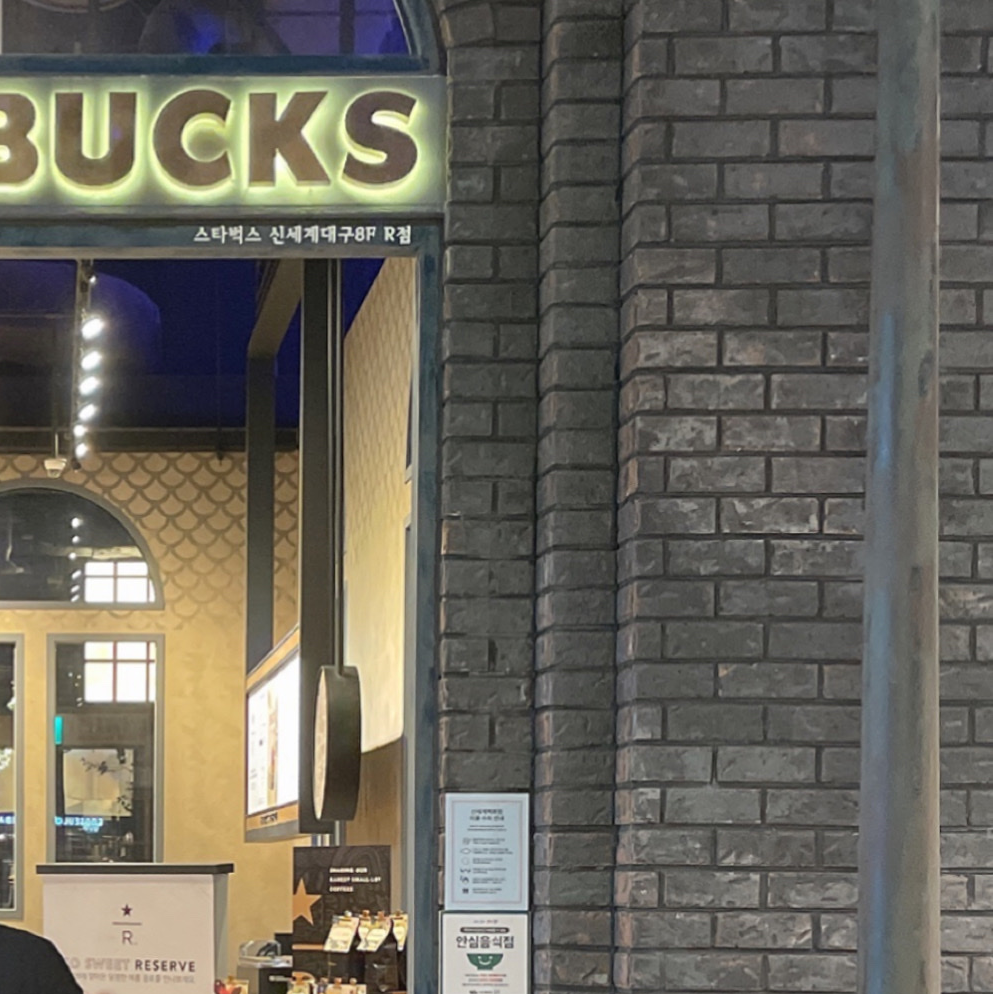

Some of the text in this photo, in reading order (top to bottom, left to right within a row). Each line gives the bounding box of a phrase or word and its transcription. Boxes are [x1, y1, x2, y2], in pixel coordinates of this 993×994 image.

[193, 225, 412, 245] 스타벅스 신세계대구8F R점
[121, 930, 133, 945] R
[456, 935, 515, 949] 안심음식점
[84, 958, 130, 971] SWEET
[134, 959, 196, 973] RESERVE
